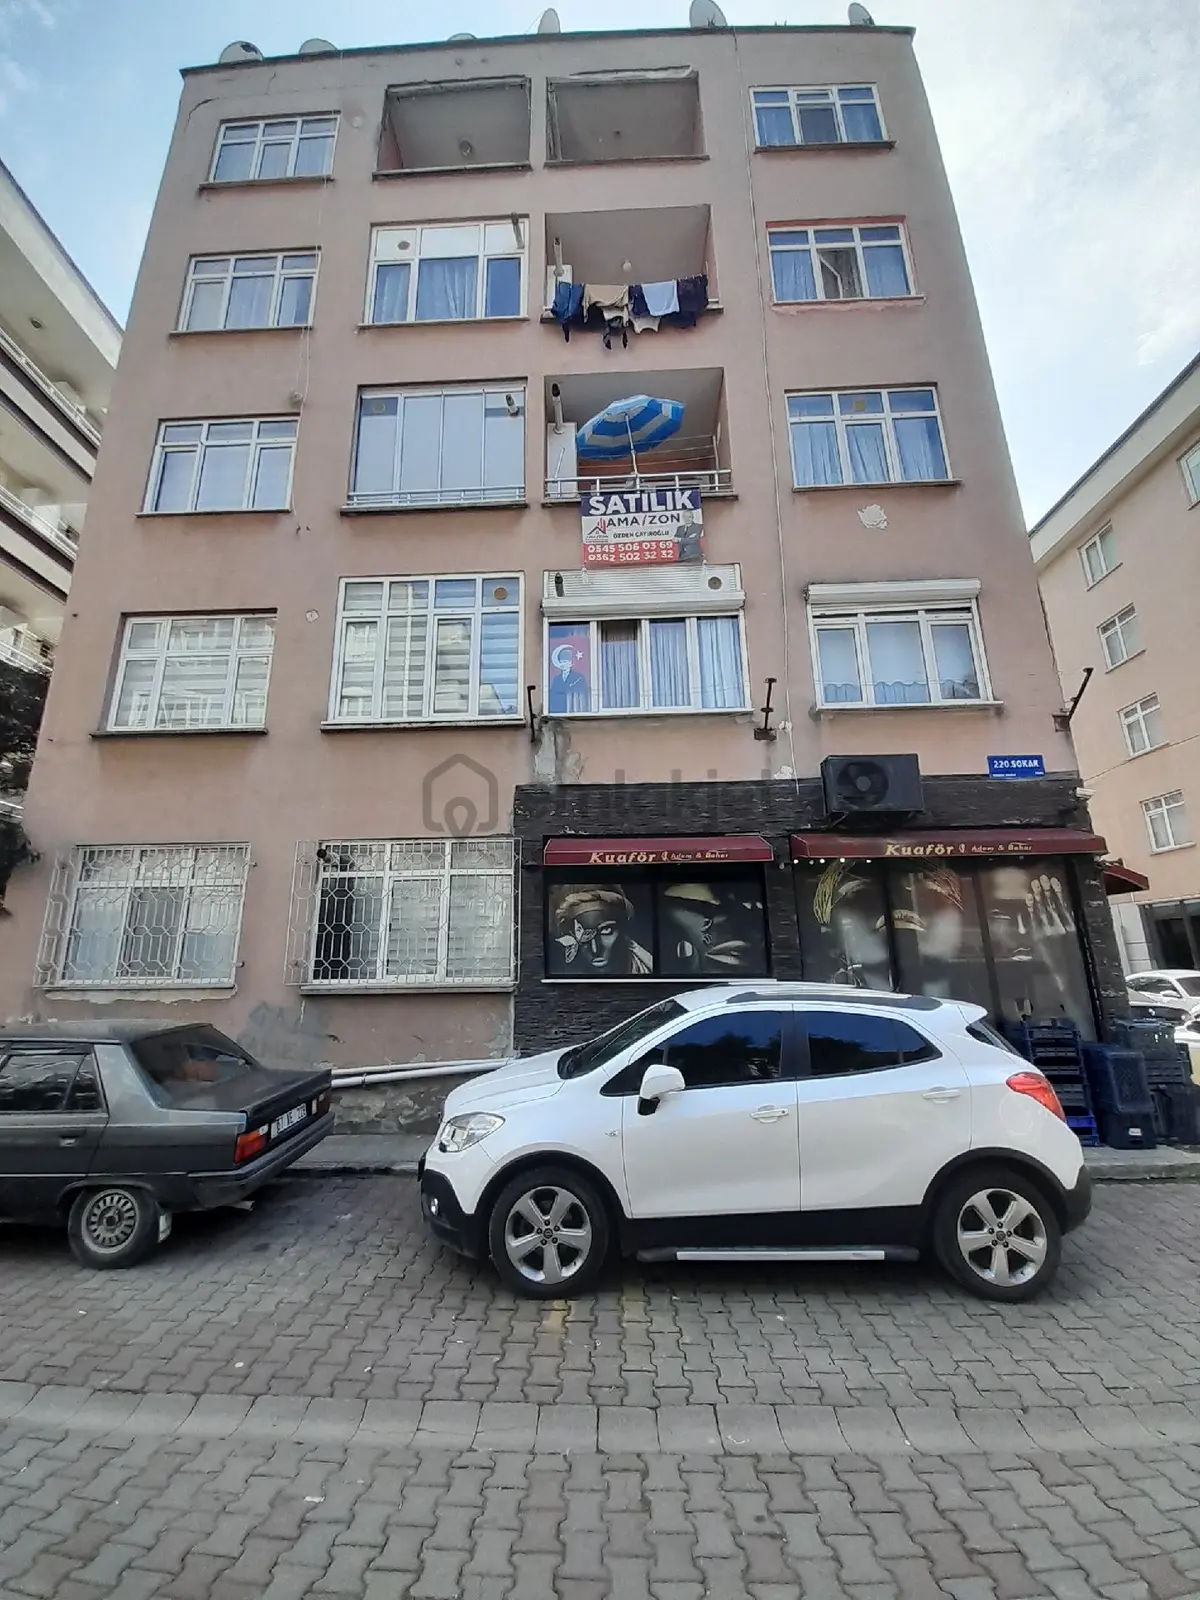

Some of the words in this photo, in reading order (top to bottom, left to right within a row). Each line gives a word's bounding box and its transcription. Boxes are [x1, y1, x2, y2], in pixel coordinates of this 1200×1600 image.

[589, 490, 694, 515] SATILIK
[587, 544, 616, 554] 0545
[618, 542, 640, 552] 506
[642, 541, 657, 550] 03
[659, 540, 673, 549] 69
[619, 552, 640, 561] 502
[643, 551, 657, 560] 32
[660, 549, 674, 558] 32
[885, 844, 954, 856] Kuaför
[588, 851, 657, 864] Kuaför
